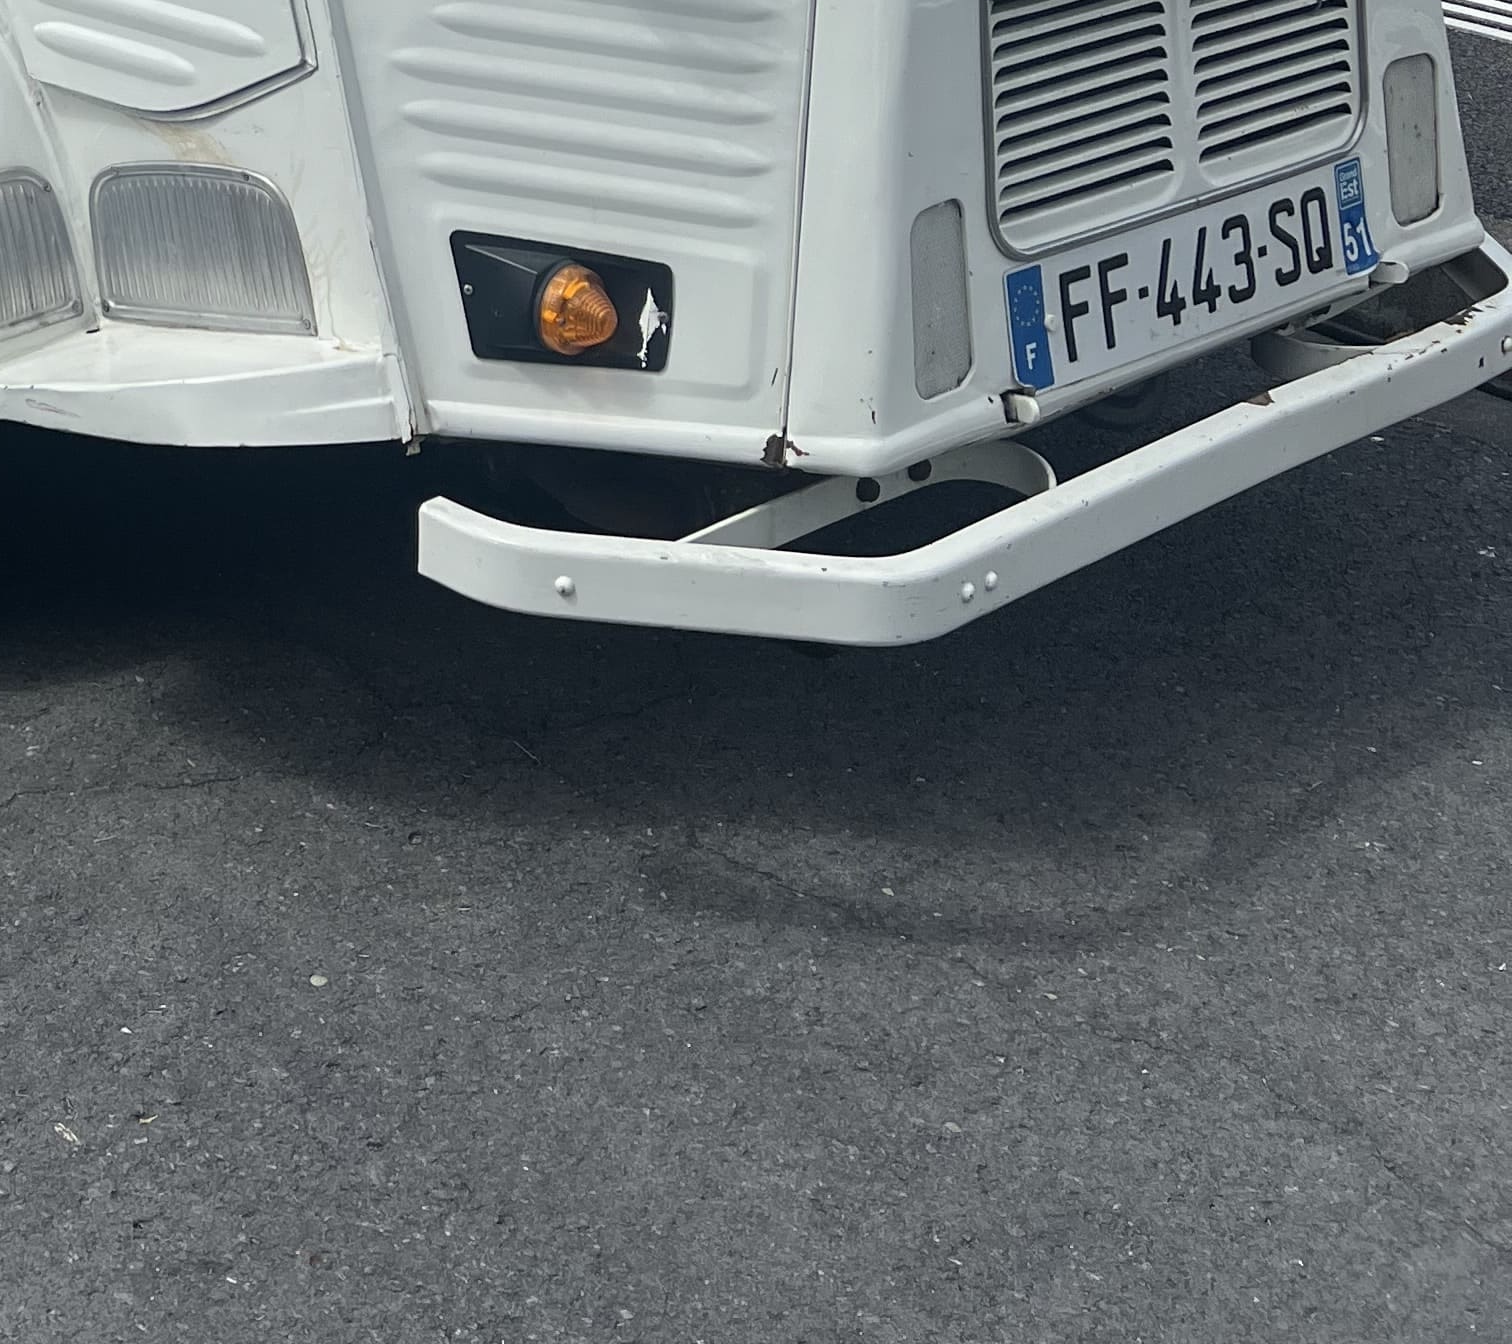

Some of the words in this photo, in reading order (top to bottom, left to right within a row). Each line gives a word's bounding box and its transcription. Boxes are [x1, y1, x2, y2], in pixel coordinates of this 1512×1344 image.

[1340, 179, 1359, 200] Est
[1343, 217, 1372, 262] 51
[1025, 342, 1037, 370] F
[1059, 186, 1333, 363] FF-443-SQ
